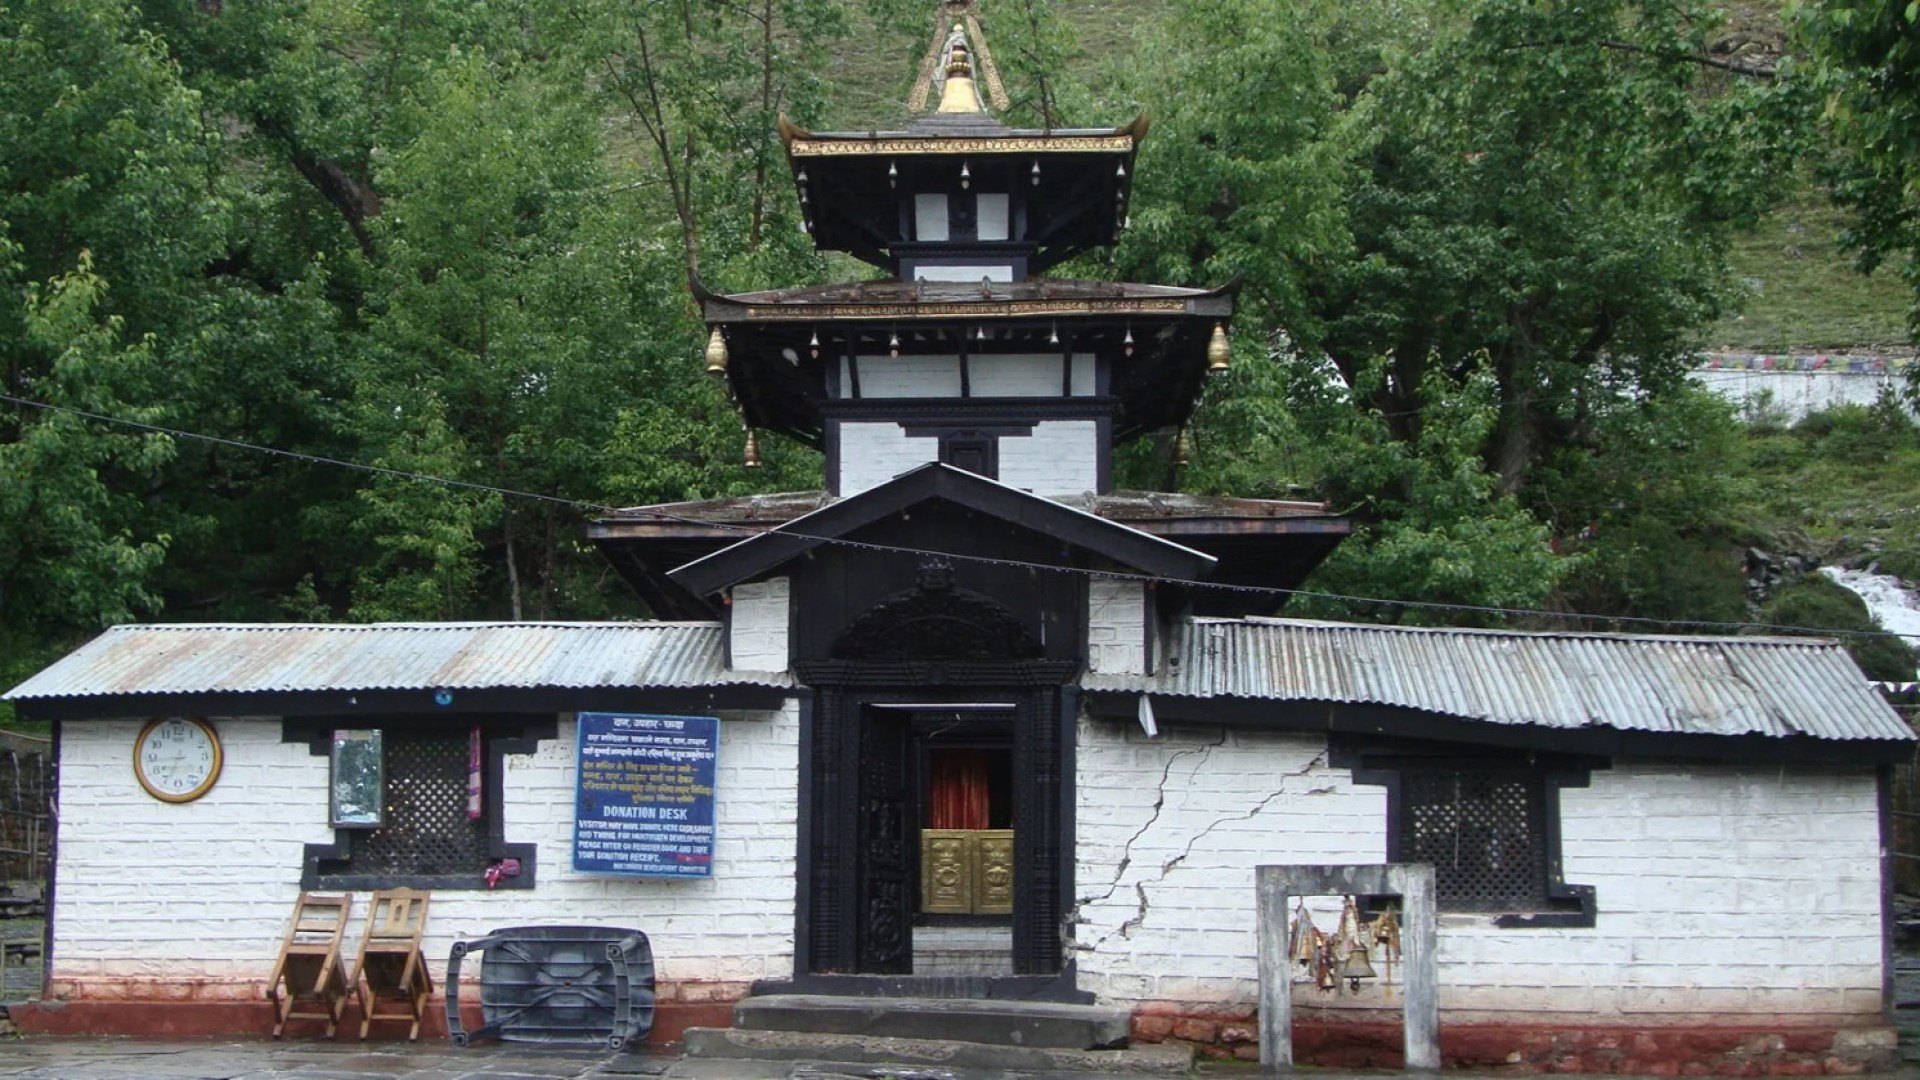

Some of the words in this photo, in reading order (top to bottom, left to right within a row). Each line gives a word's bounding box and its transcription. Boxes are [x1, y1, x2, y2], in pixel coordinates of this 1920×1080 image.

[603, 806, 655, 818] DONATION
[659, 808, 687, 820] DESK
[619, 832, 631, 840] FOR
[579, 841, 601, 849] PLEASE
[633, 843, 660, 851] REGISTER
[679, 845, 691, 853] AND
[692, 846, 708, 854] TAKE
[578, 851, 595, 859] YOUR
[597, 852, 628, 861] DONATION
